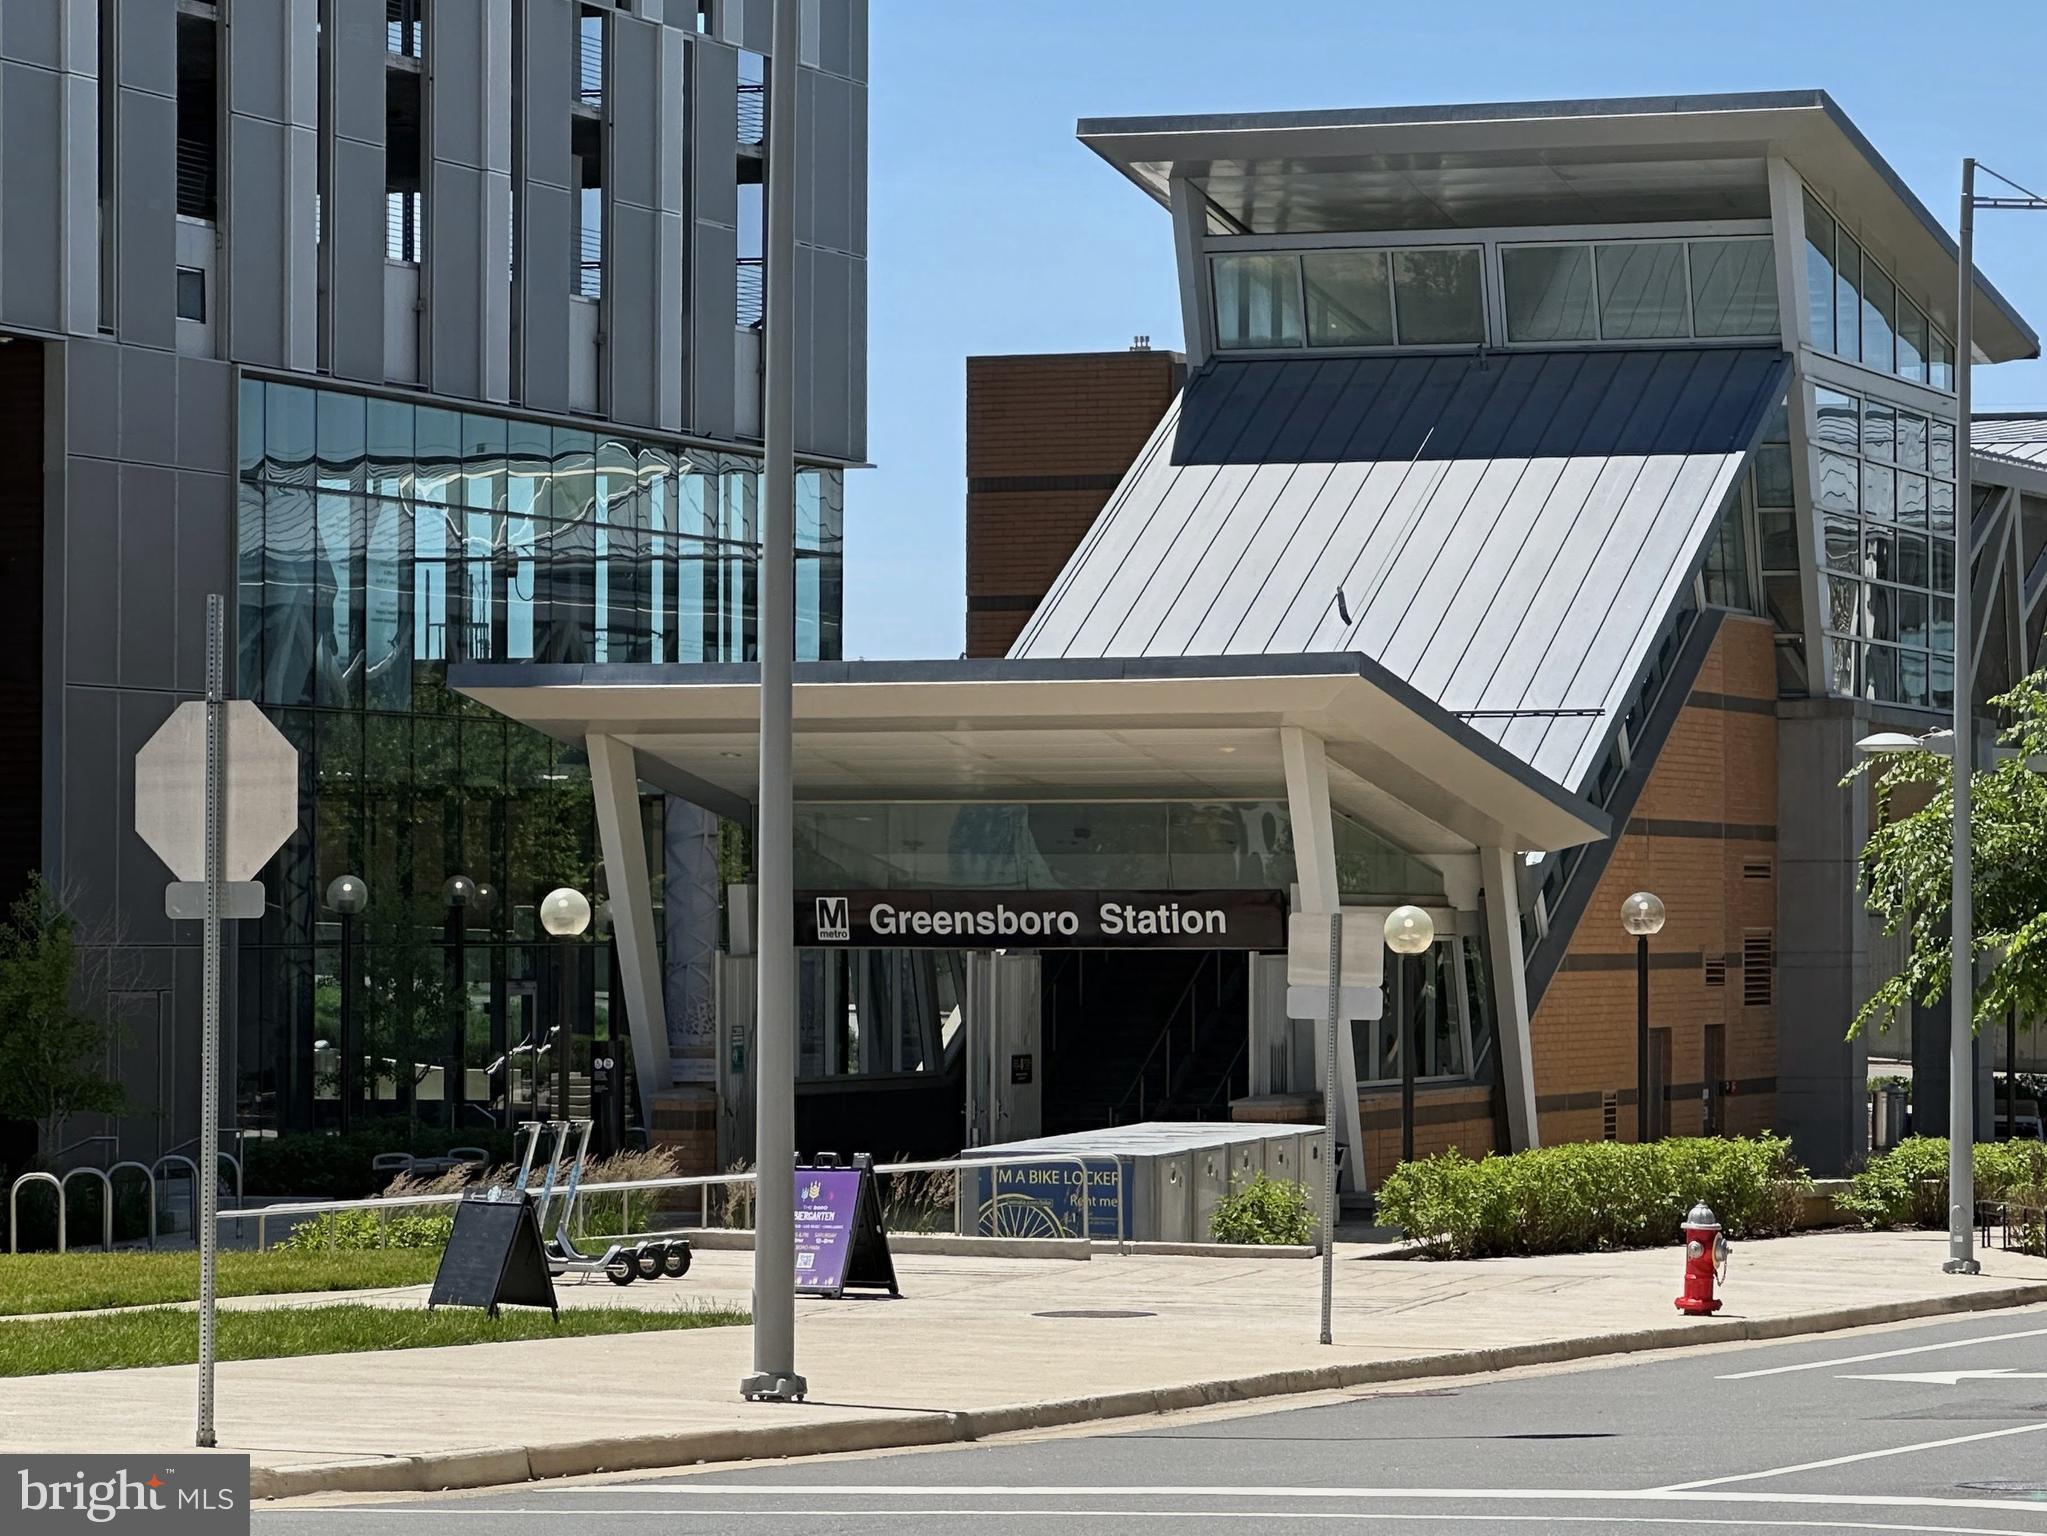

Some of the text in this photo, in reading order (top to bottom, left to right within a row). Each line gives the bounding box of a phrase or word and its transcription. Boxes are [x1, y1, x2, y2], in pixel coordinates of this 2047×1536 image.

[818, 899, 847, 928] M
[869, 902, 1227, 935] Greensboro Station
[820, 929, 847, 938] metro
[1015, 1169, 1026, 1184] A
[1028, 1169, 1060, 1185] BIKE
